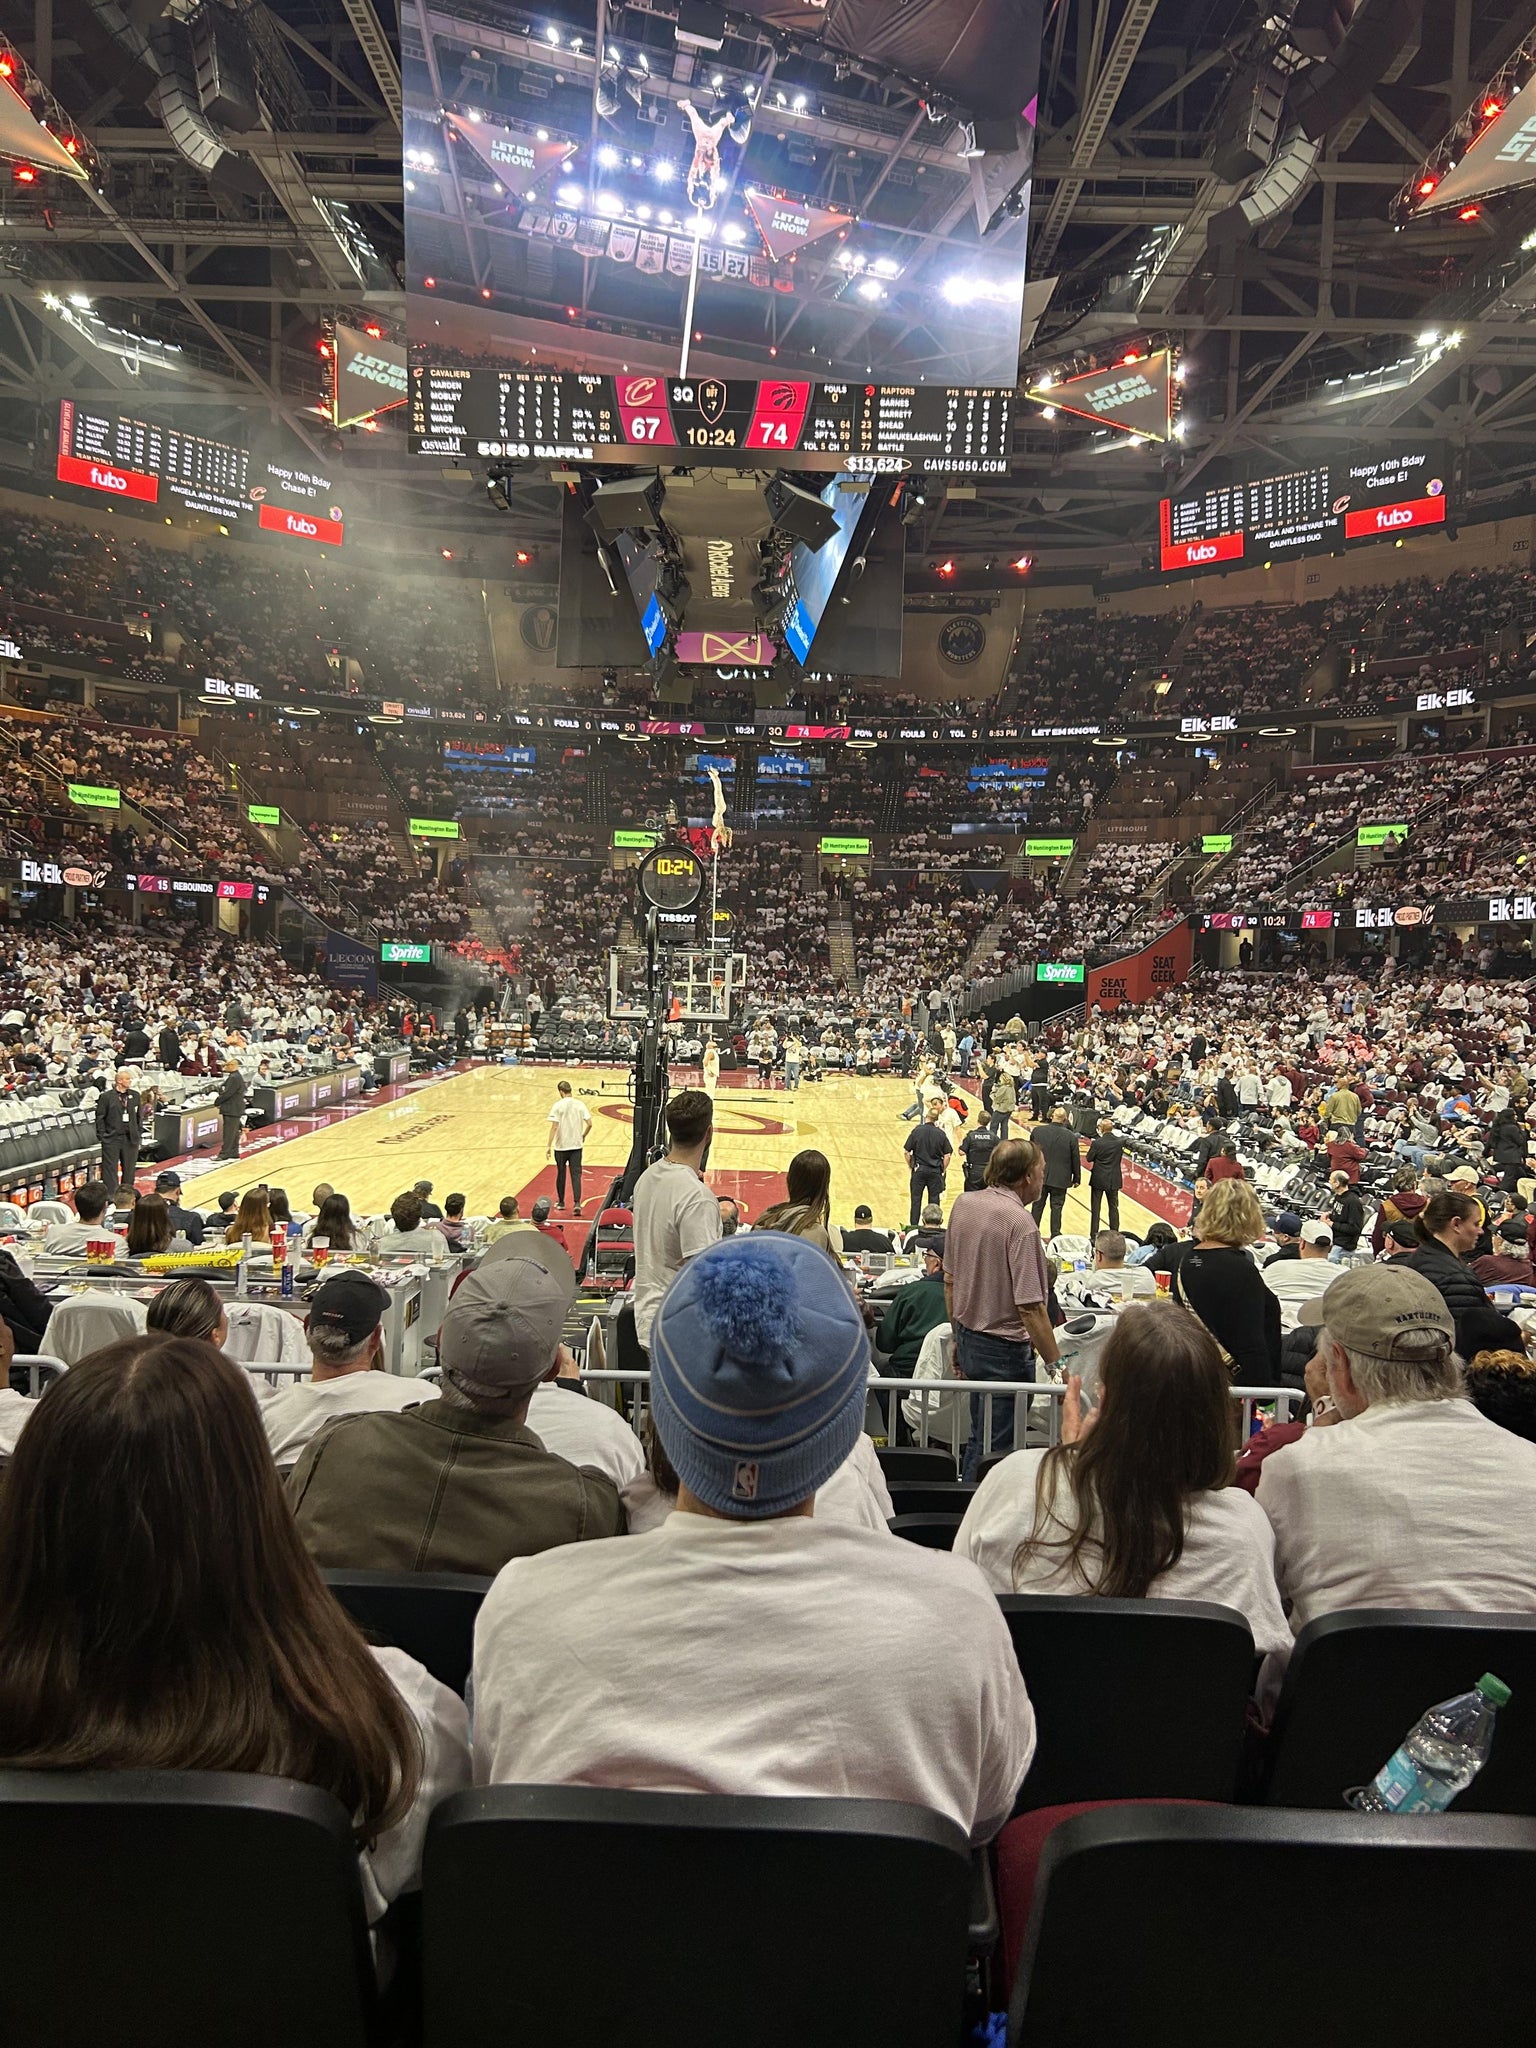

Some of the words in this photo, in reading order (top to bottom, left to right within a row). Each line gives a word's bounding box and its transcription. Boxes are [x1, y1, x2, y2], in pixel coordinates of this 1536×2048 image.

[492, 140, 516, 153] LET
[516, 146, 535, 157] EM
[490, 150, 536, 169] KNOW.
[702, 254, 718, 270] 15
[728, 260, 745, 276] 27
[354, 352, 390, 371] LET
[430, 369, 471, 379] CAVALIERS
[578, 376, 602, 385] FOULS
[430, 380, 462, 390] HARDEN
[824, 385, 847, 394] FOULS
[1084, 382, 1118, 403] LET
[1117, 374, 1148, 391] EM
[430, 391, 462, 402] MOBLEY
[673, 388, 694, 403] 3Q
[880, 388, 915, 396] RAPTORS
[982, 390, 995, 398] AST
[1091, 383, 1158, 412] KNOW.
[413, 402, 424, 411] 31
[430, 403, 455, 413] ALLEN
[880, 400, 910, 408] BARNES
[413, 413, 424, 422] 32
[430, 414, 453, 424] WADE
[600, 411, 610, 420] 50
[879, 411, 912, 419] BARRETT
[413, 424, 426, 434] 45
[430, 425, 467, 436] MITCHELL
[600, 422, 610, 431] 50
[631, 417, 661, 440] 67
[840, 420, 850, 429] 64
[861, 421, 872, 429] 23
[878, 422, 904, 430] SHEAD
[572, 433, 587, 442] TOL
[599, 435, 610, 443] CH
[687, 428, 736, 446] 10:24
[760, 423, 788, 445] 74
[840, 432, 850, 441] 59
[861, 432, 872, 440] 54
[421, 437, 462, 452] oswald
[803, 442, 818, 450] TOL
[828, 443, 839, 451] CH
[861, 443, 871, 451] 77
[878, 443, 904, 452] BATTLE
[533, 445, 594, 459] RAFFLE
[849, 457, 903, 473] $13,624
[924, 460, 1007, 473] CAVS5050.COM
[1350, 462, 1378, 478] Happy
[1380, 459, 1400, 472] 10th
[1401, 454, 1426, 470] Bday
[90, 467, 127, 490] fubo
[267, 464, 293, 480] Happy
[294, 469, 311, 483] 10th
[312, 473, 331, 490] Bday
[1366, 474, 1395, 489] Chase
[281, 480, 306, 495] Chase
[184, 500, 222, 515] DAUNTLESS
[198, 491, 212, 501] AND
[241, 501, 253, 512] THE
[1376, 508, 1413, 528] fubo
[287, 516, 317, 536] fubo
[1281, 527, 1294, 536] AND
[1325, 518, 1337, 527] THE
[1270, 535, 1305, 549] DAUNTLESS
[1187, 545, 1217, 562] fubo
[708, 550, 734, 577] Rocket
[710, 577, 735, 597] Arena
[441, 711, 466, 719] $13,624
[515, 716, 531, 725] TOL
[554, 719, 580, 729] FOULS
[625, 723, 635, 732] 50
[680, 724, 691, 734] 67
[735, 726, 755, 735] 10:24
[768, 726, 782, 736] 3Q
[798, 727, 809, 737] 74
[877, 730, 888, 739] 64
[900, 730, 926, 738] FOULS
[949, 730, 966, 738] TOL
[1031, 728, 1051, 736] LET
[1107, 825, 1148, 833] LITEHOUSE
[657, 859, 694, 876] 10:24
[158, 880, 168, 891] 15
[172, 882, 214, 893] REBOUNDS
[223, 885, 235, 895] 20
[659, 914, 697, 924] TISSOT
[1231, 916, 1244, 928] 67
[1248, 917, 1258, 925] 3Q
[1262, 916, 1286, 927] 10:24
[1305, 915, 1315, 926] 74
[389, 944, 423, 961] Sprite
[1153, 956, 1175, 968] SEAT
[1044, 965, 1077, 980] Sprite
[1151, 970, 1175, 982] GEEK
[1101, 978, 1127, 988] SEAT
[1100, 989, 1127, 999] GEEK
[1395, 1312, 1441, 1324] NANTUCKET
